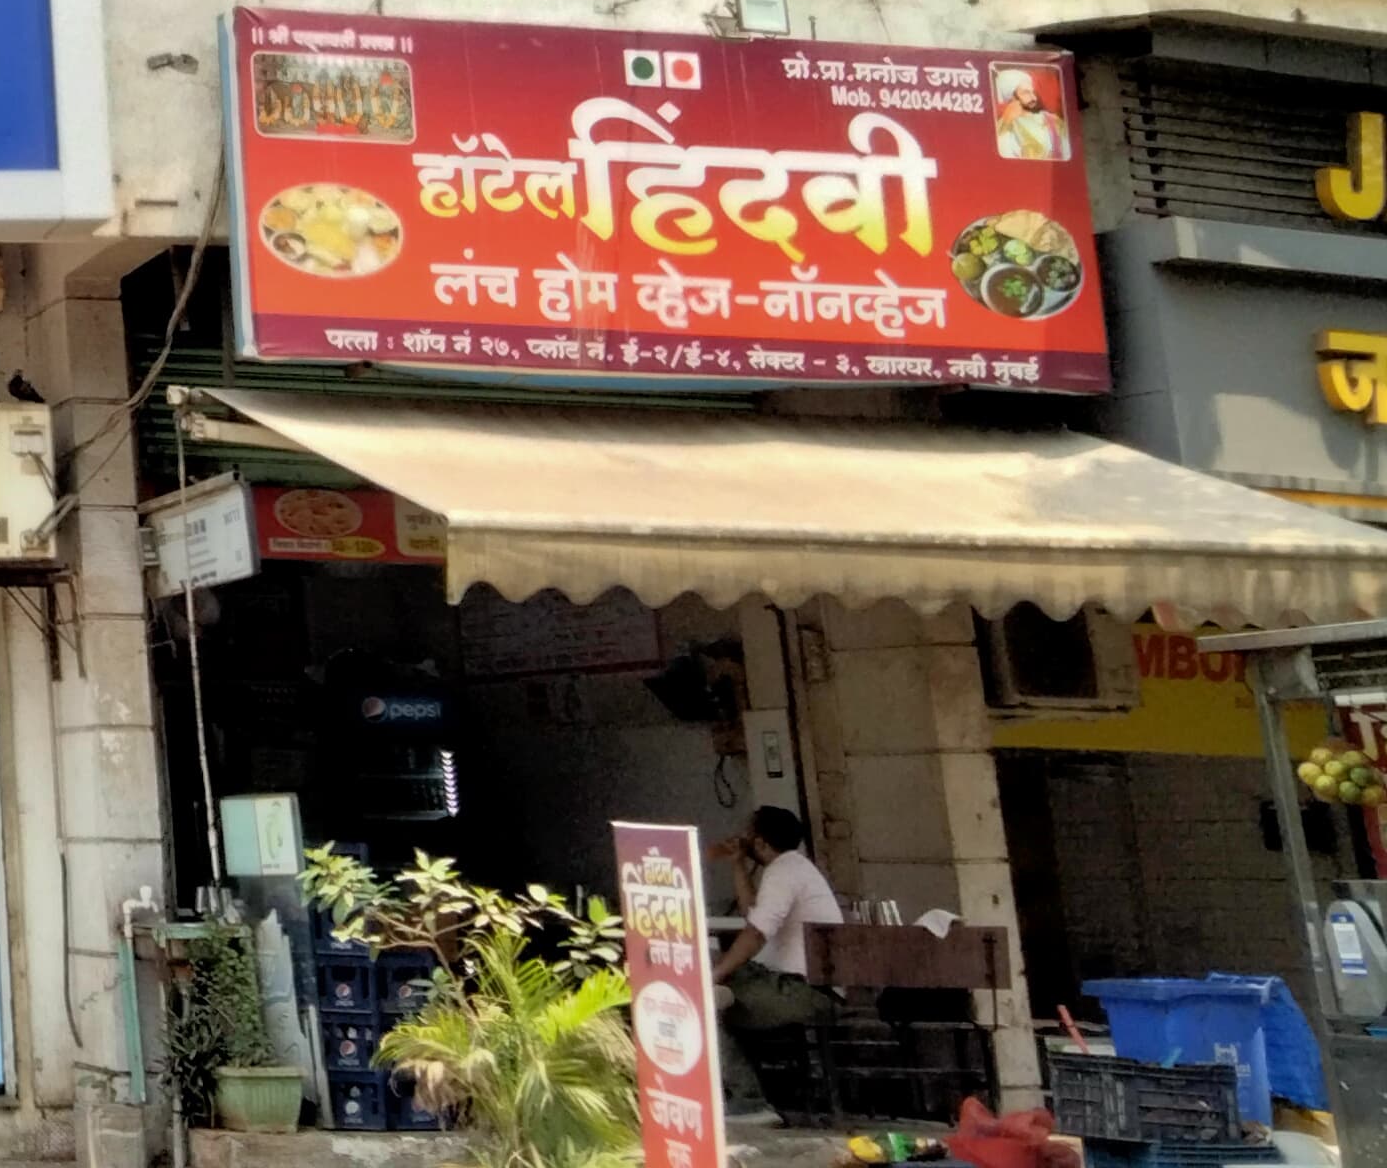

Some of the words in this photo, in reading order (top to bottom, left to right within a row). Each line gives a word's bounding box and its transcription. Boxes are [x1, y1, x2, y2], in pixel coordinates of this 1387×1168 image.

[924, 62, 979, 89] उगले
[831, 85, 876, 108] Mob.
[880, 89, 984, 113] 9420344282
[413, 132, 576, 220] हॉटेल
[568, 96, 938, 263] हिंदवी
[430, 248, 519, 307] लंच
[533, 252, 618, 322] होम
[632, 257, 948, 338] व्हेज-नॉनव्हेज
[324, 329, 378, 352] पत्ता
[402, 328, 446, 354] शॉप
[452, 330, 471, 355] नं
[526, 335, 580, 360] प्लॉट
[746, 345, 805, 371] सेक्टर
[948, 353, 987, 379] नवी
[991, 353, 1040, 386] मुंबई
[390, 701, 442, 720] pepsi
